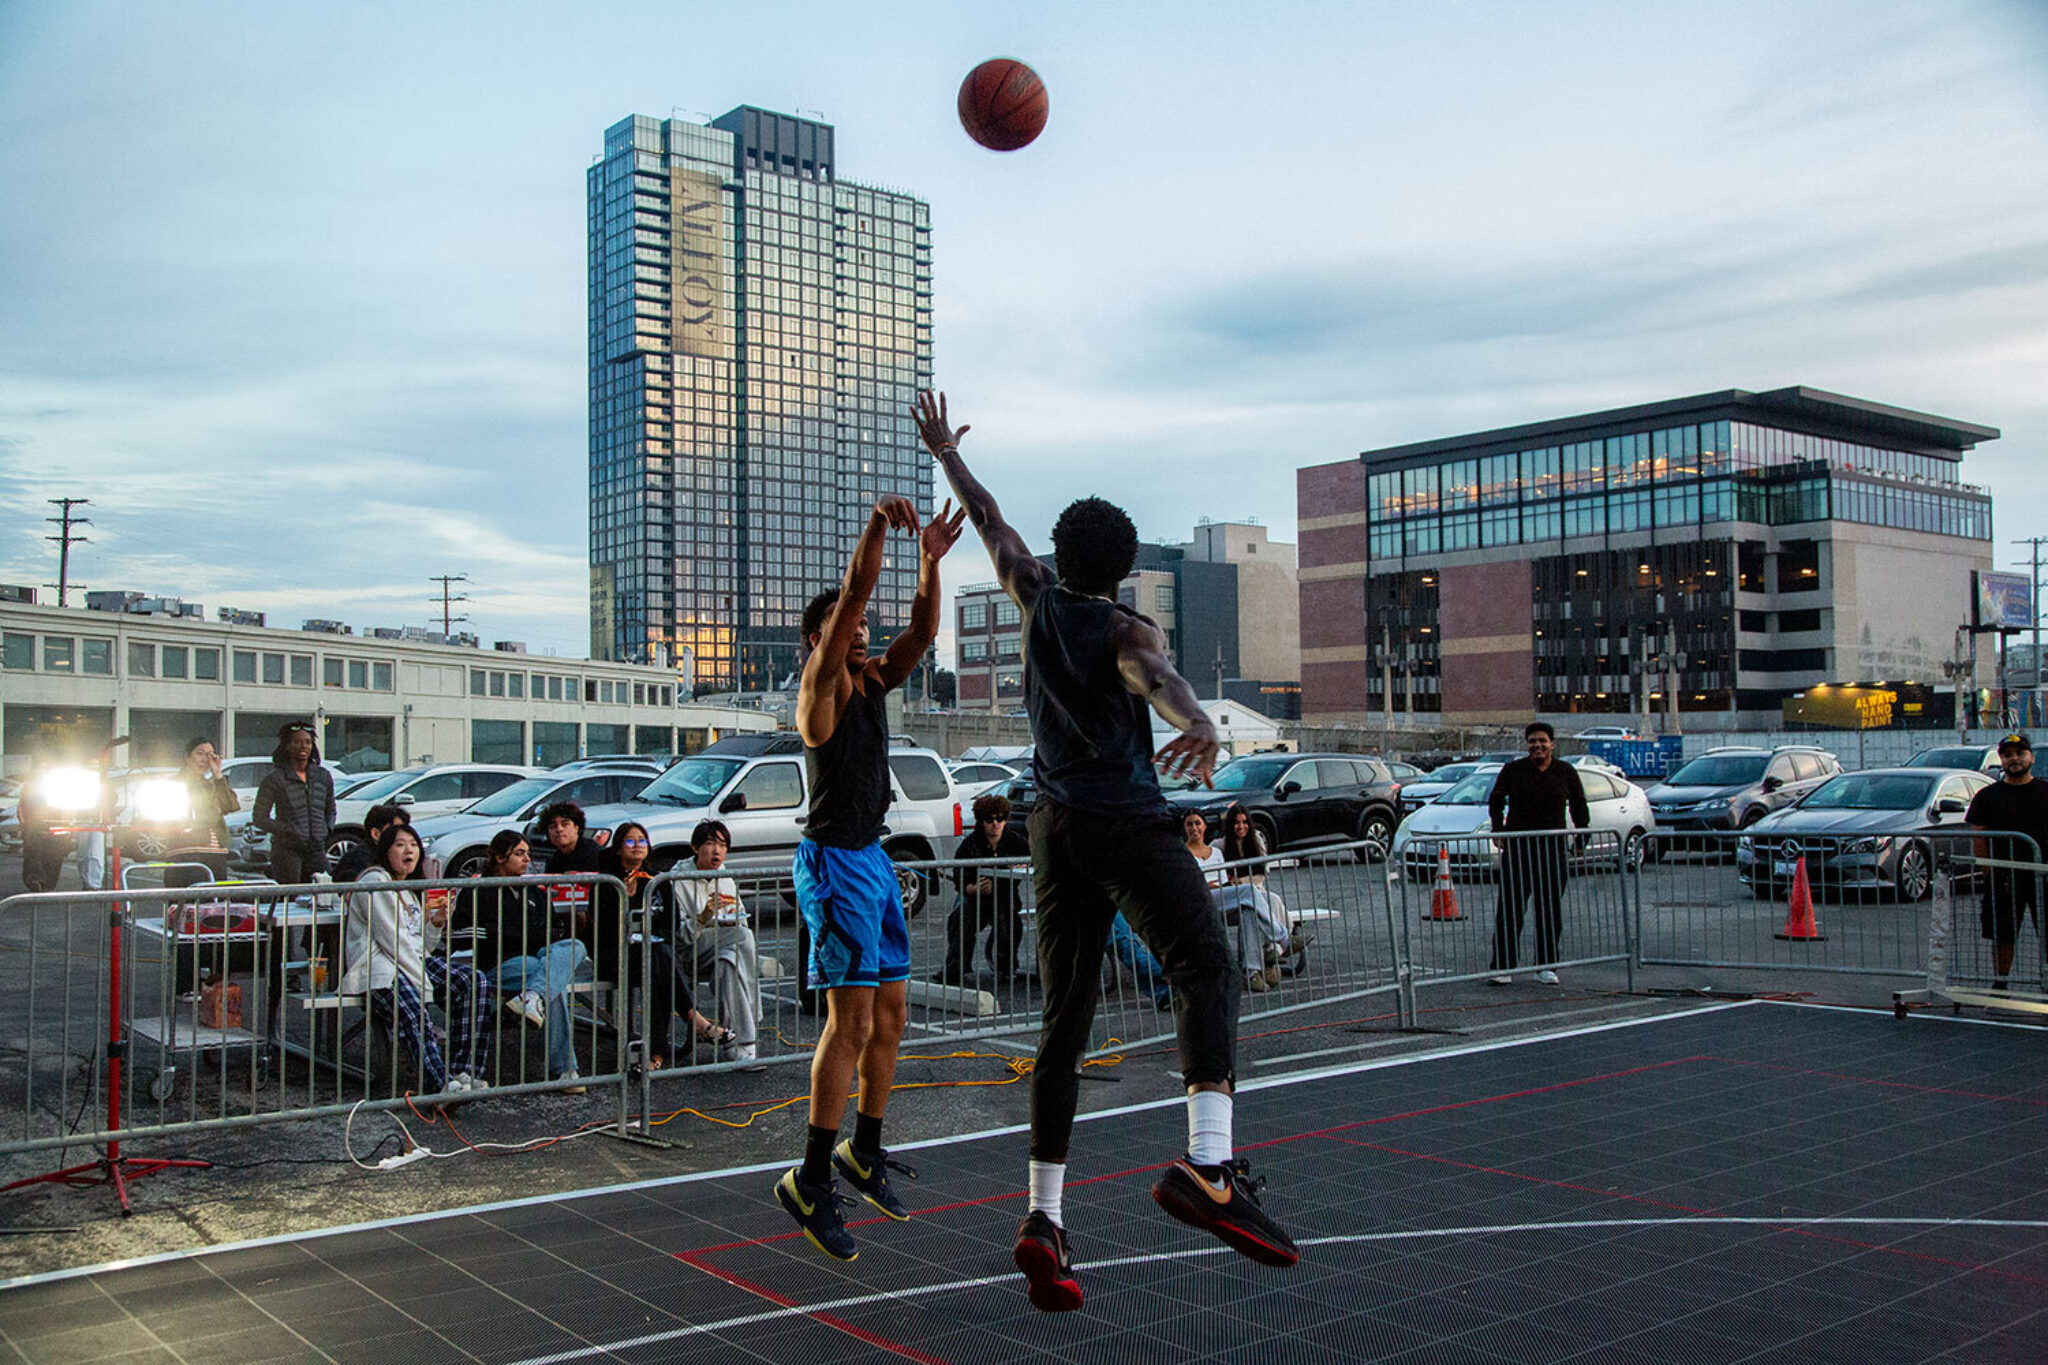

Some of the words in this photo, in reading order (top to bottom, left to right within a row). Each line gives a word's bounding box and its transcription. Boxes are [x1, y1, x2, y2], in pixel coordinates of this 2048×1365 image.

[682, 186, 713, 339] ALLOY
[1855, 691, 1897, 709] ALWAYS
[1861, 703, 1892, 718] HAND
[1861, 713, 1893, 729] PAINT
